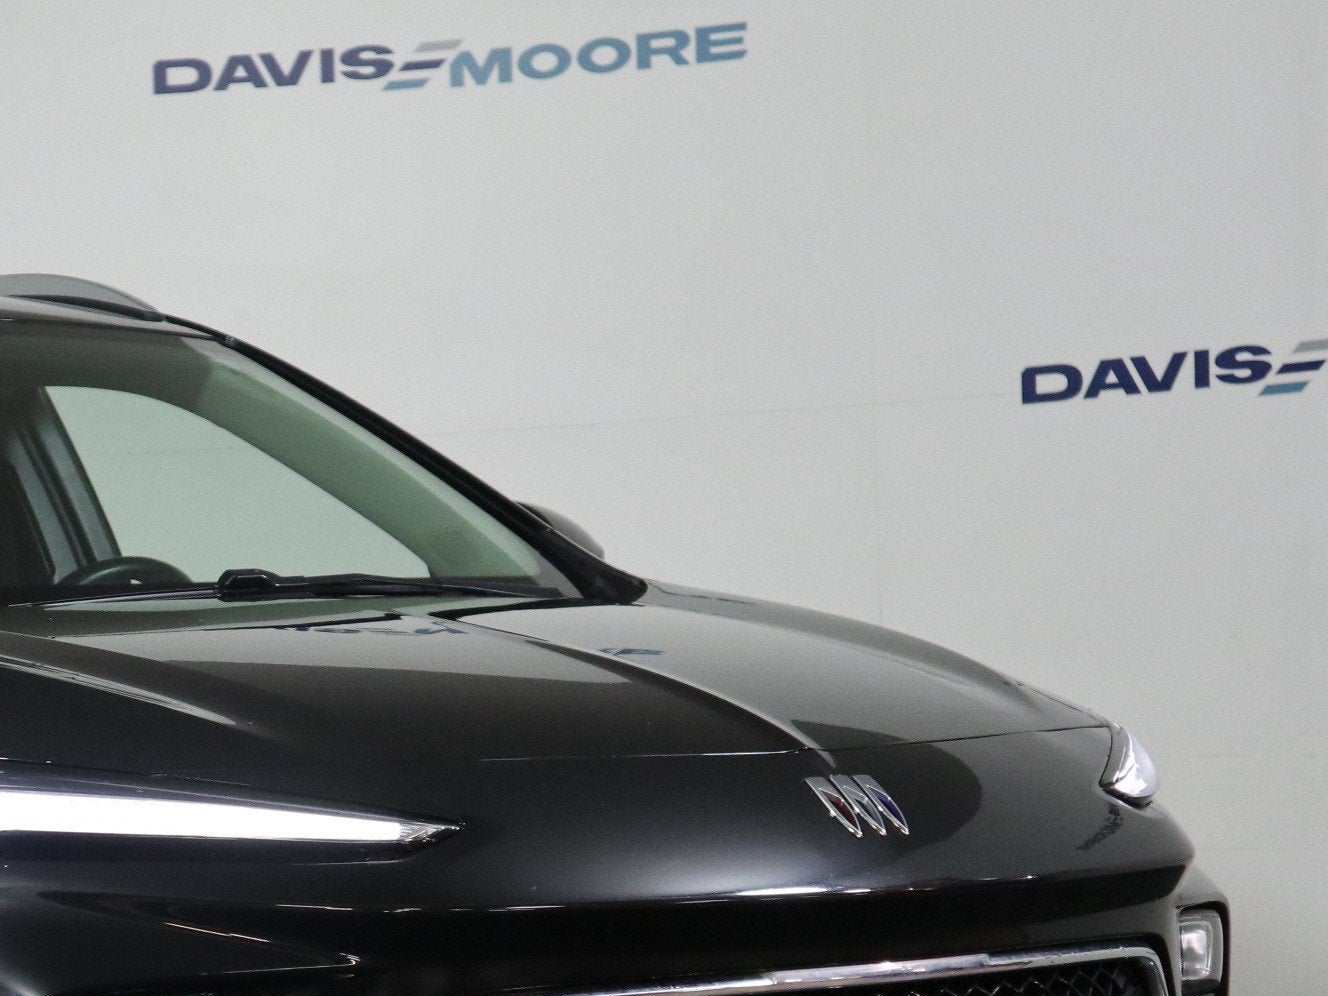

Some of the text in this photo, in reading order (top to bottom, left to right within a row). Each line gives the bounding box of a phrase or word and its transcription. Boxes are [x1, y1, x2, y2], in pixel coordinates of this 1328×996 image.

[152, 21, 748, 95] DAVIS MOORE
[1021, 344, 1273, 405] DAVIS
